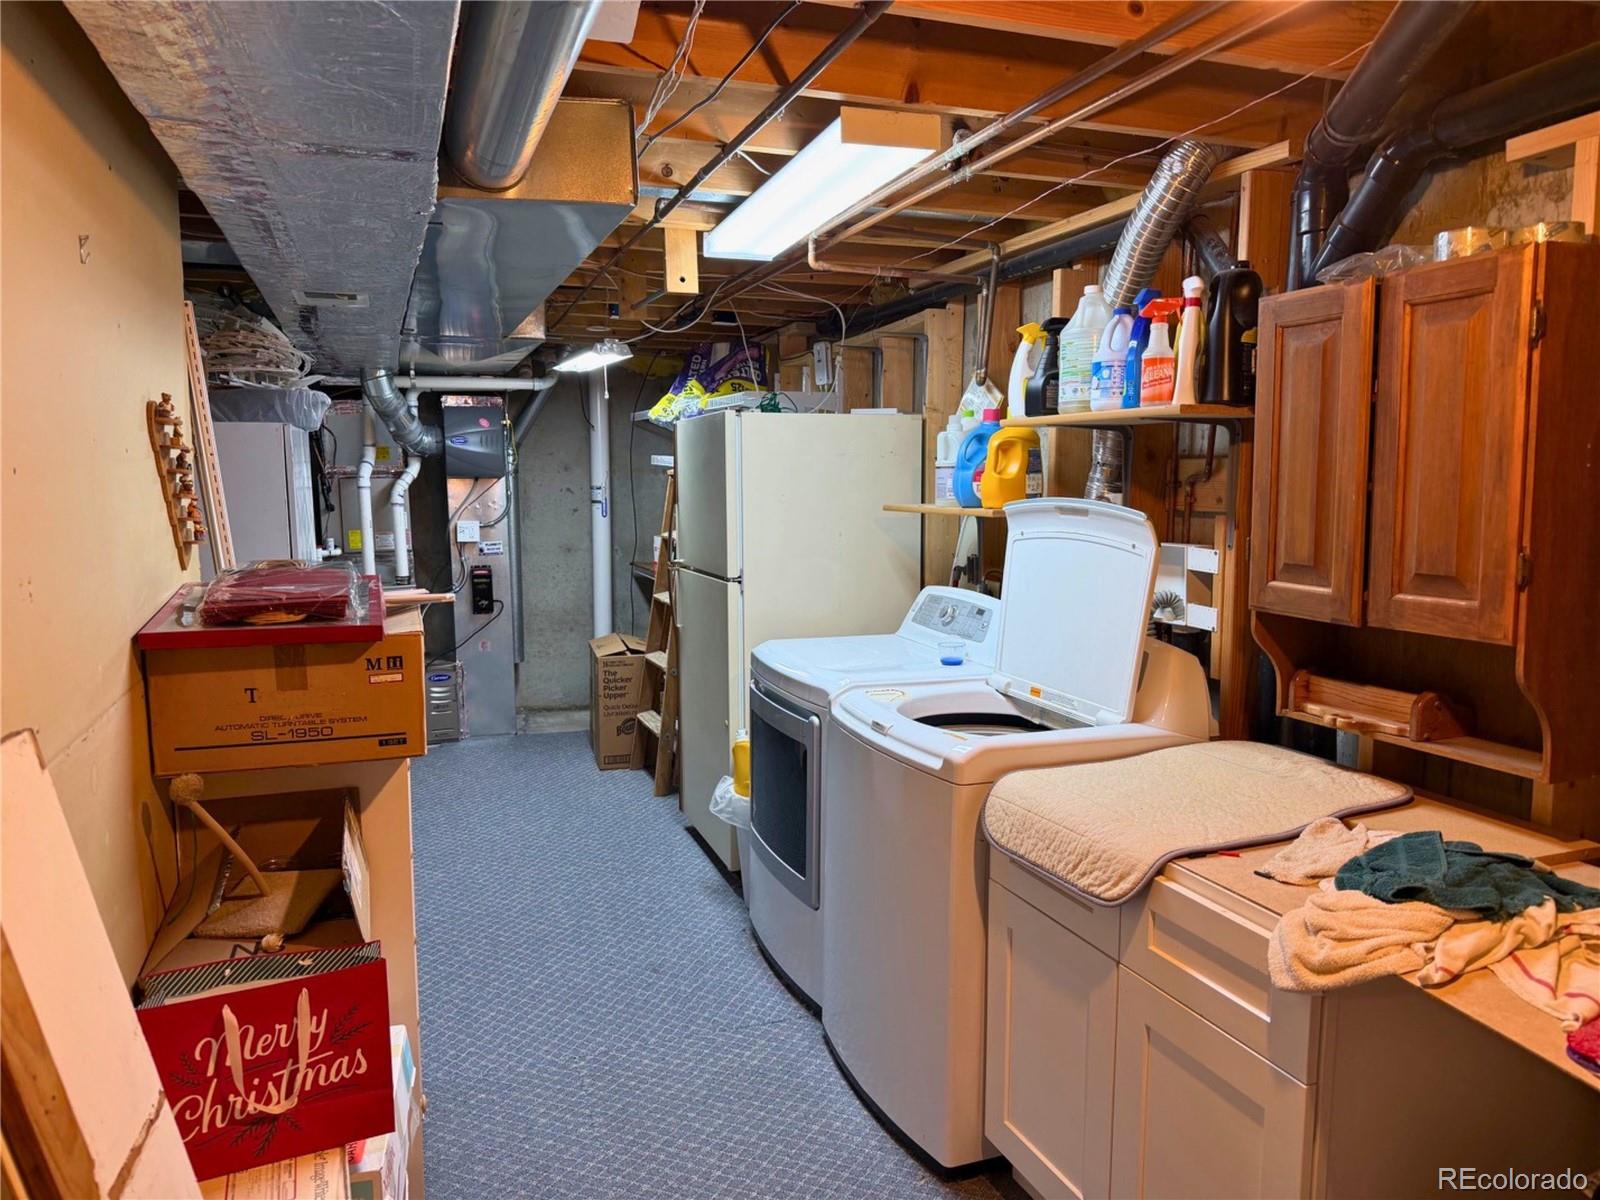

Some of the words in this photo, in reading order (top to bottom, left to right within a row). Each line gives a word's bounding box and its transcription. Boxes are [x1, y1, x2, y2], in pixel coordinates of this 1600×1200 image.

[603, 684, 628, 692] Picker
[214, 722, 269, 732] AUTOMATIC
[271, 719, 328, 729] TURNTABLE
[328, 715, 368, 724] SYSTEM
[250, 726, 334, 742] SL-1950
[172, 1047, 368, 1143] Christmas
